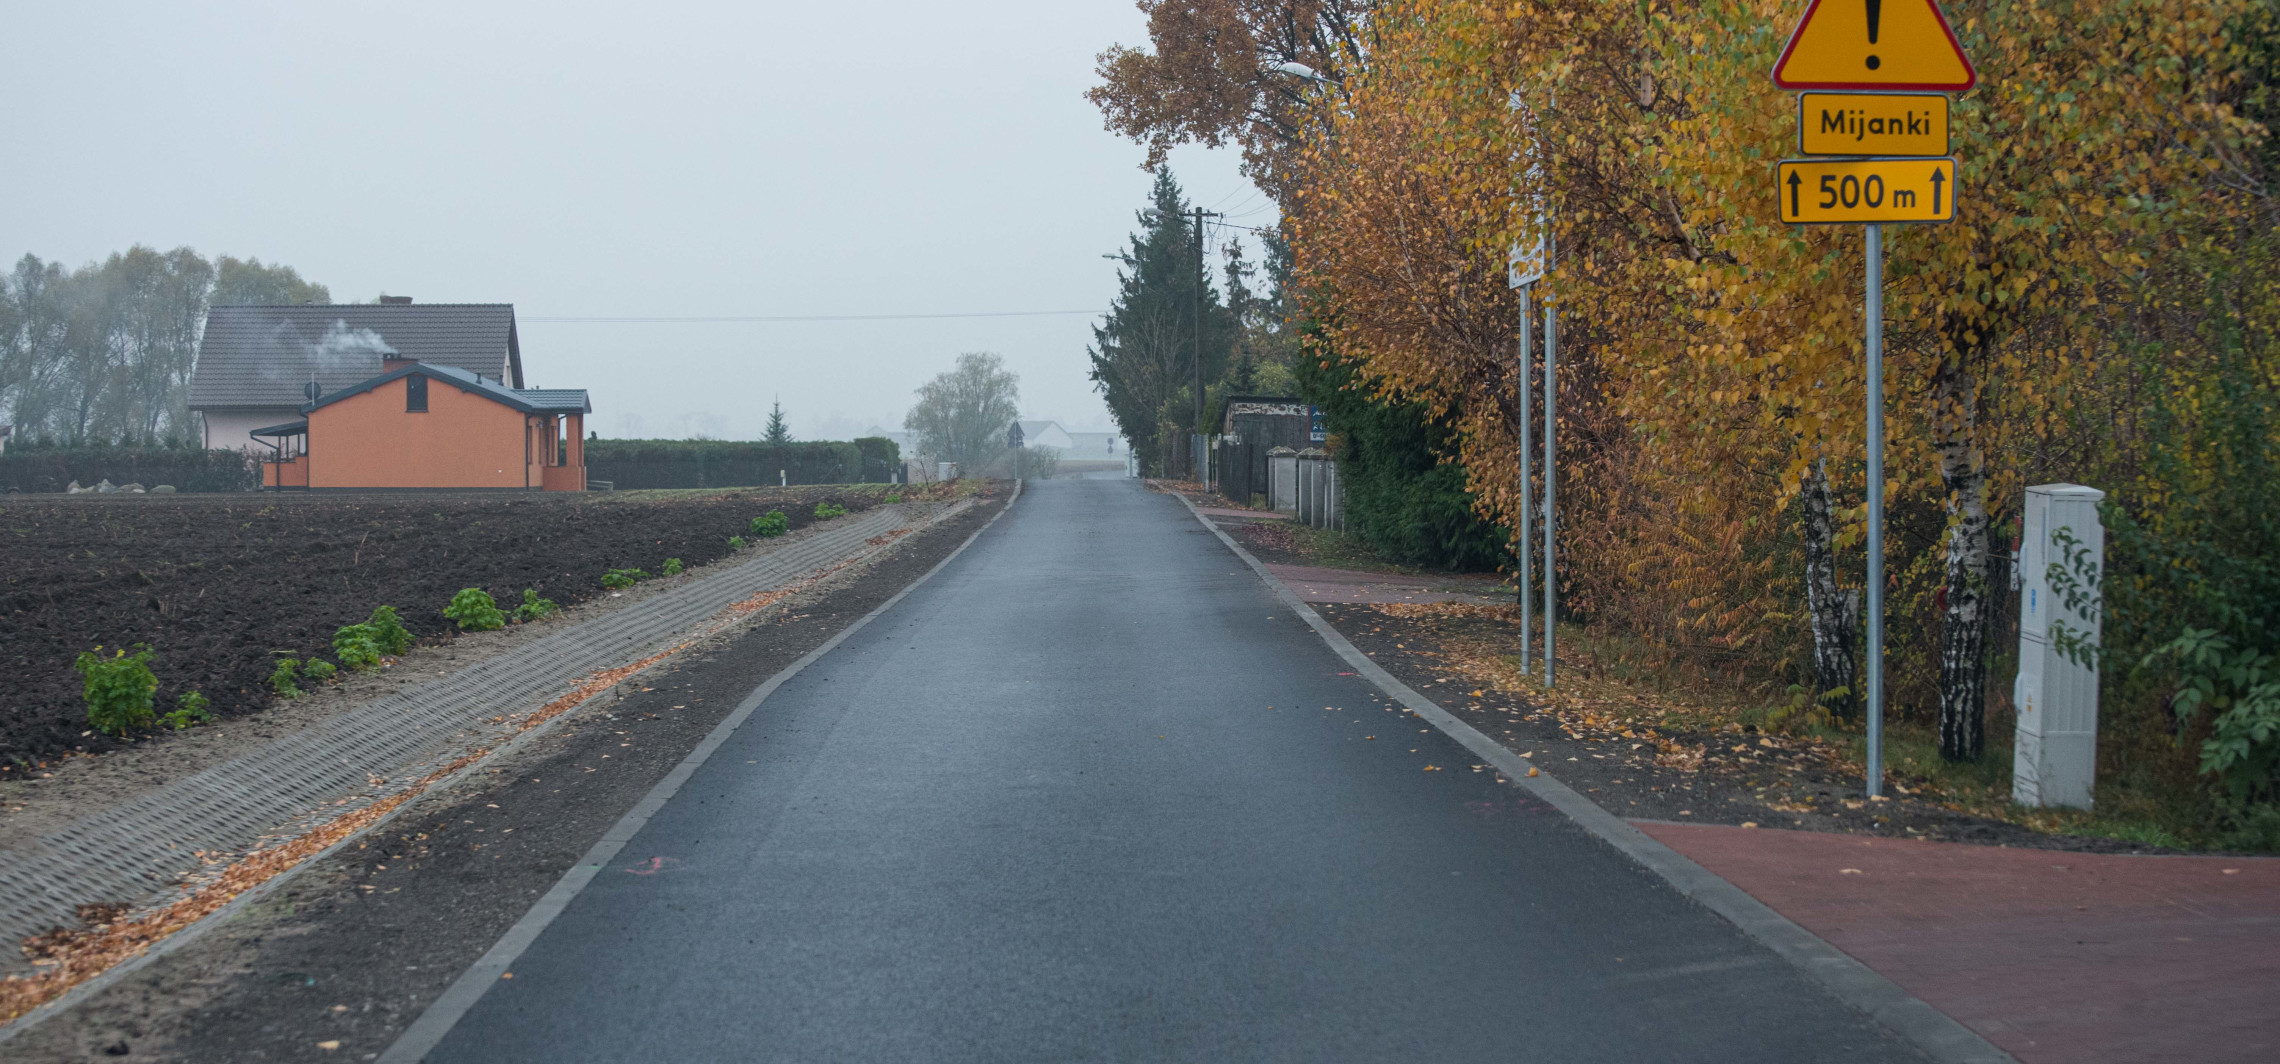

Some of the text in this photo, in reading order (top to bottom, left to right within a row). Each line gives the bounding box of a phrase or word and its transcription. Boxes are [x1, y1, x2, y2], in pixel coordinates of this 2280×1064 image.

[1821, 109, 1930, 141] Mijanki
[1819, 174, 1916, 209] 500 m
